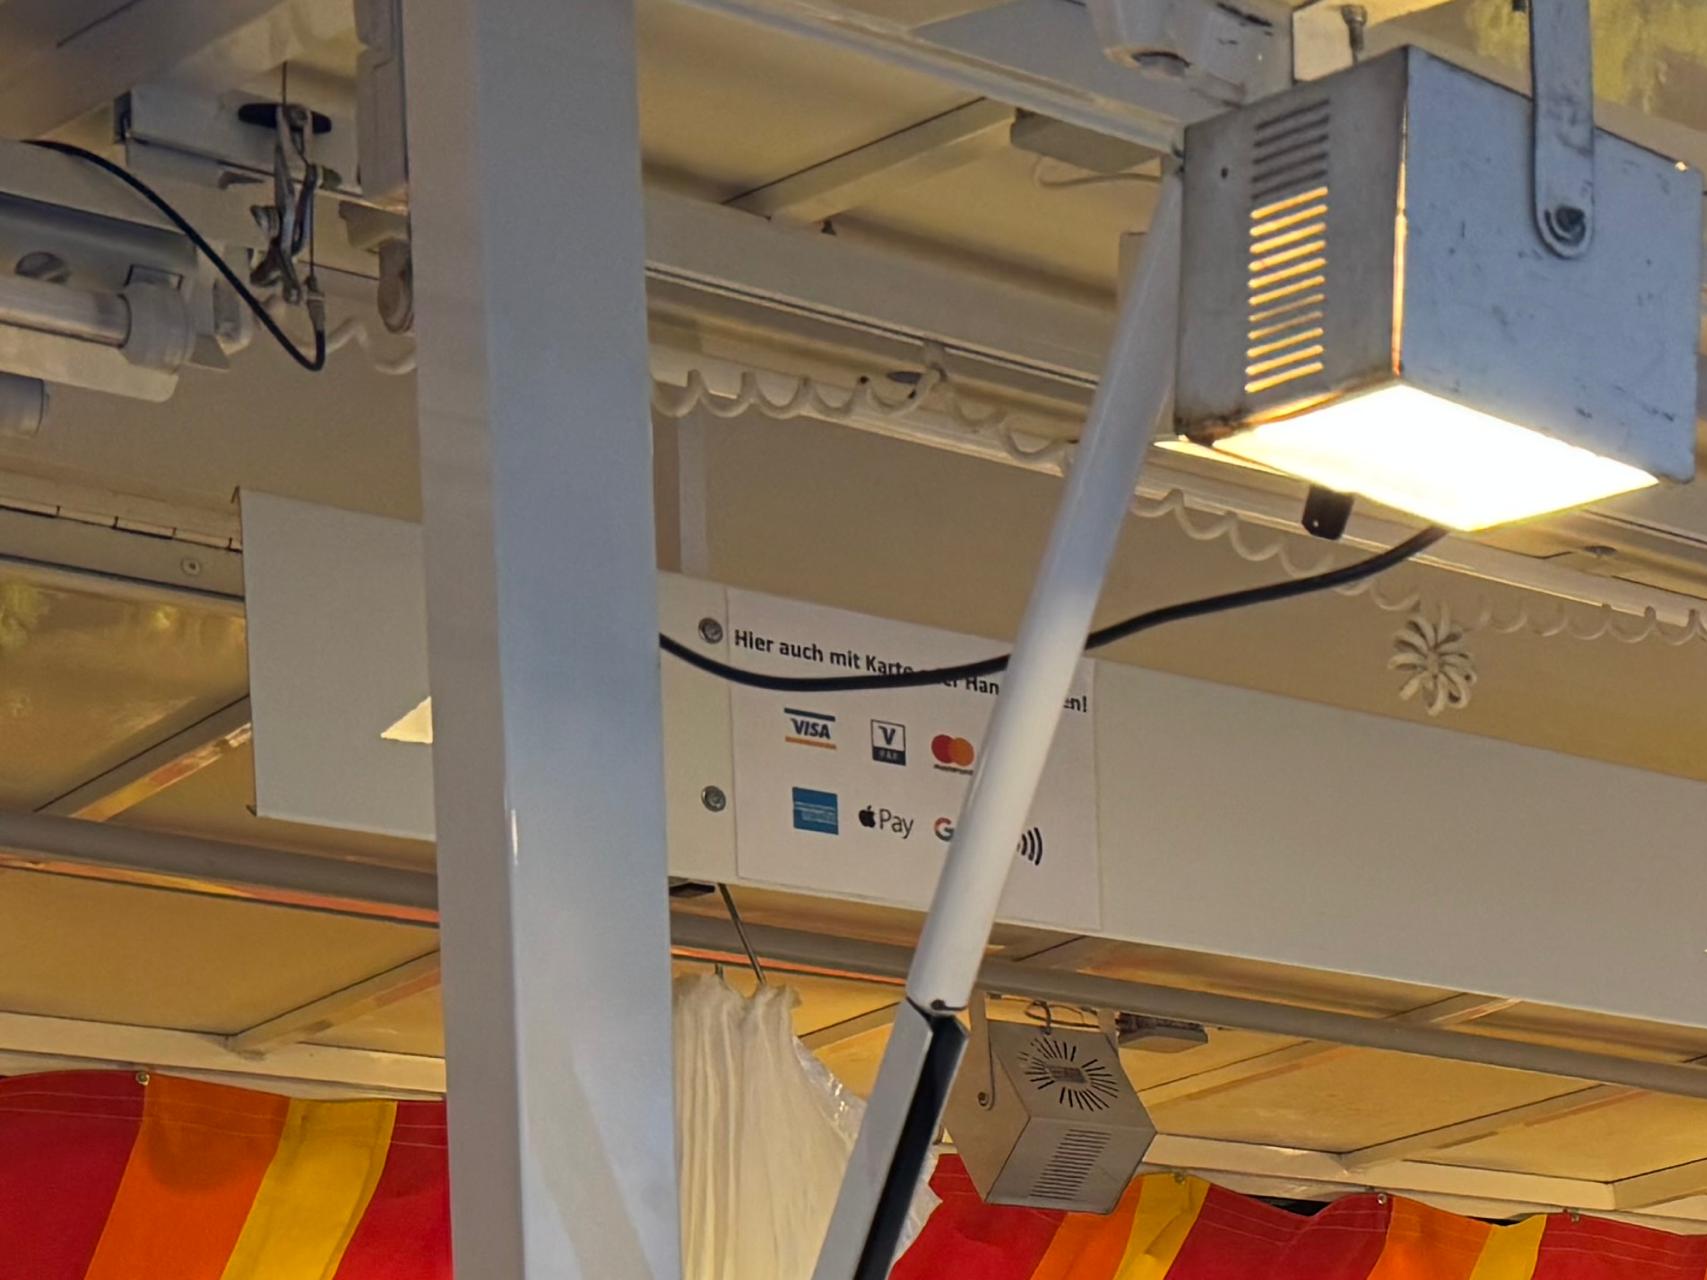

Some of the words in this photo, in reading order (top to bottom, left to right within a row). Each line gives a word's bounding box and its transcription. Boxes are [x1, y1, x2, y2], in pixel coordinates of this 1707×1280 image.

[734, 629, 774, 652] Hier
[779, 640, 823, 662] auch
[830, 651, 860, 669] mit
[789, 717, 831, 740] VISA
[879, 808, 914, 839] Pay
